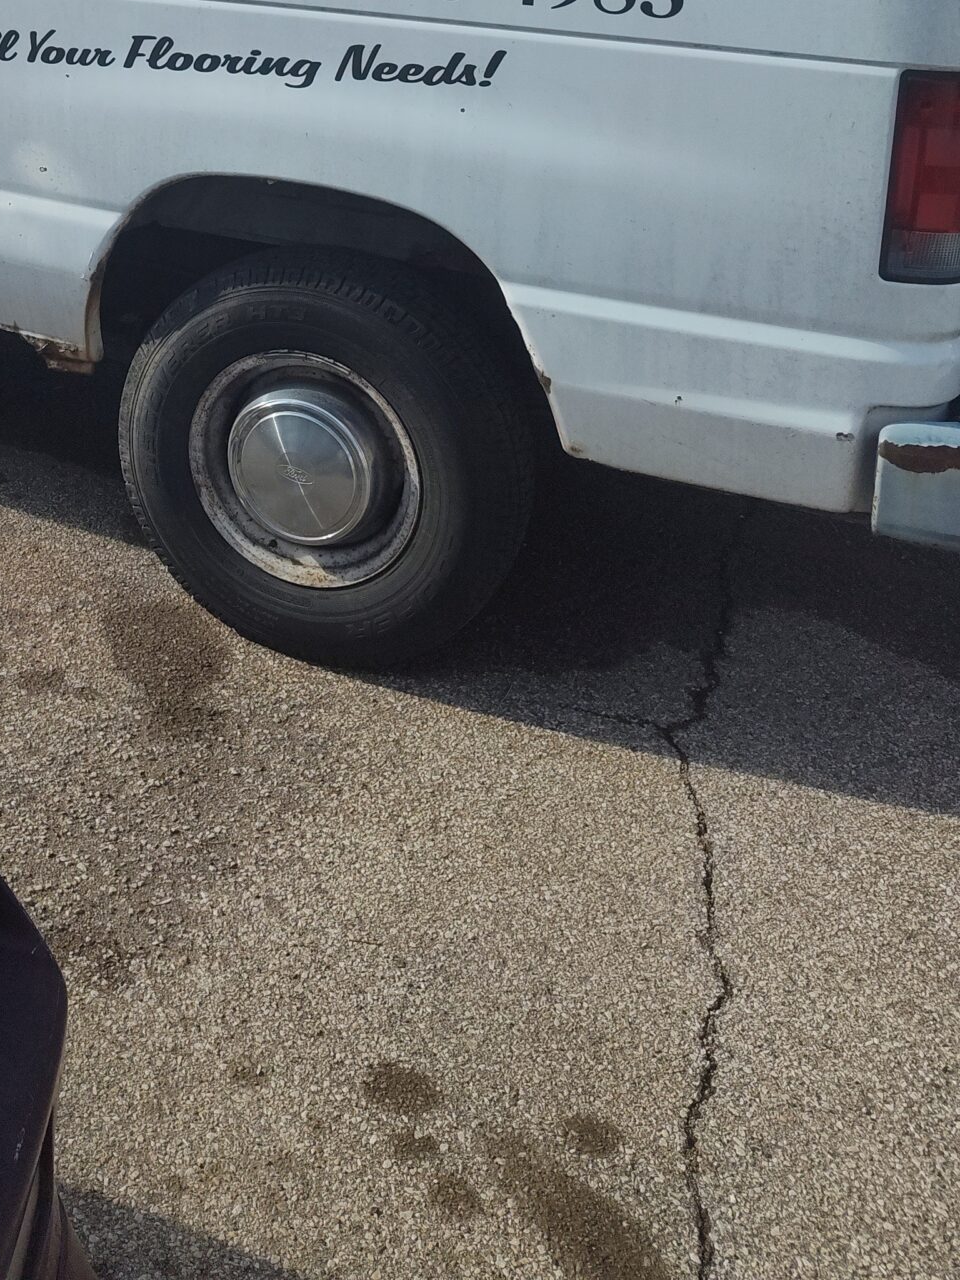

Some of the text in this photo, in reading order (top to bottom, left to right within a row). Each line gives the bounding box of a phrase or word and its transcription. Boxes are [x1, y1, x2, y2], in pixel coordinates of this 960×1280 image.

[27, 30, 116, 67] Your
[123, 35, 322, 88] Flooring
[334, 44, 508, 88] Needs!
